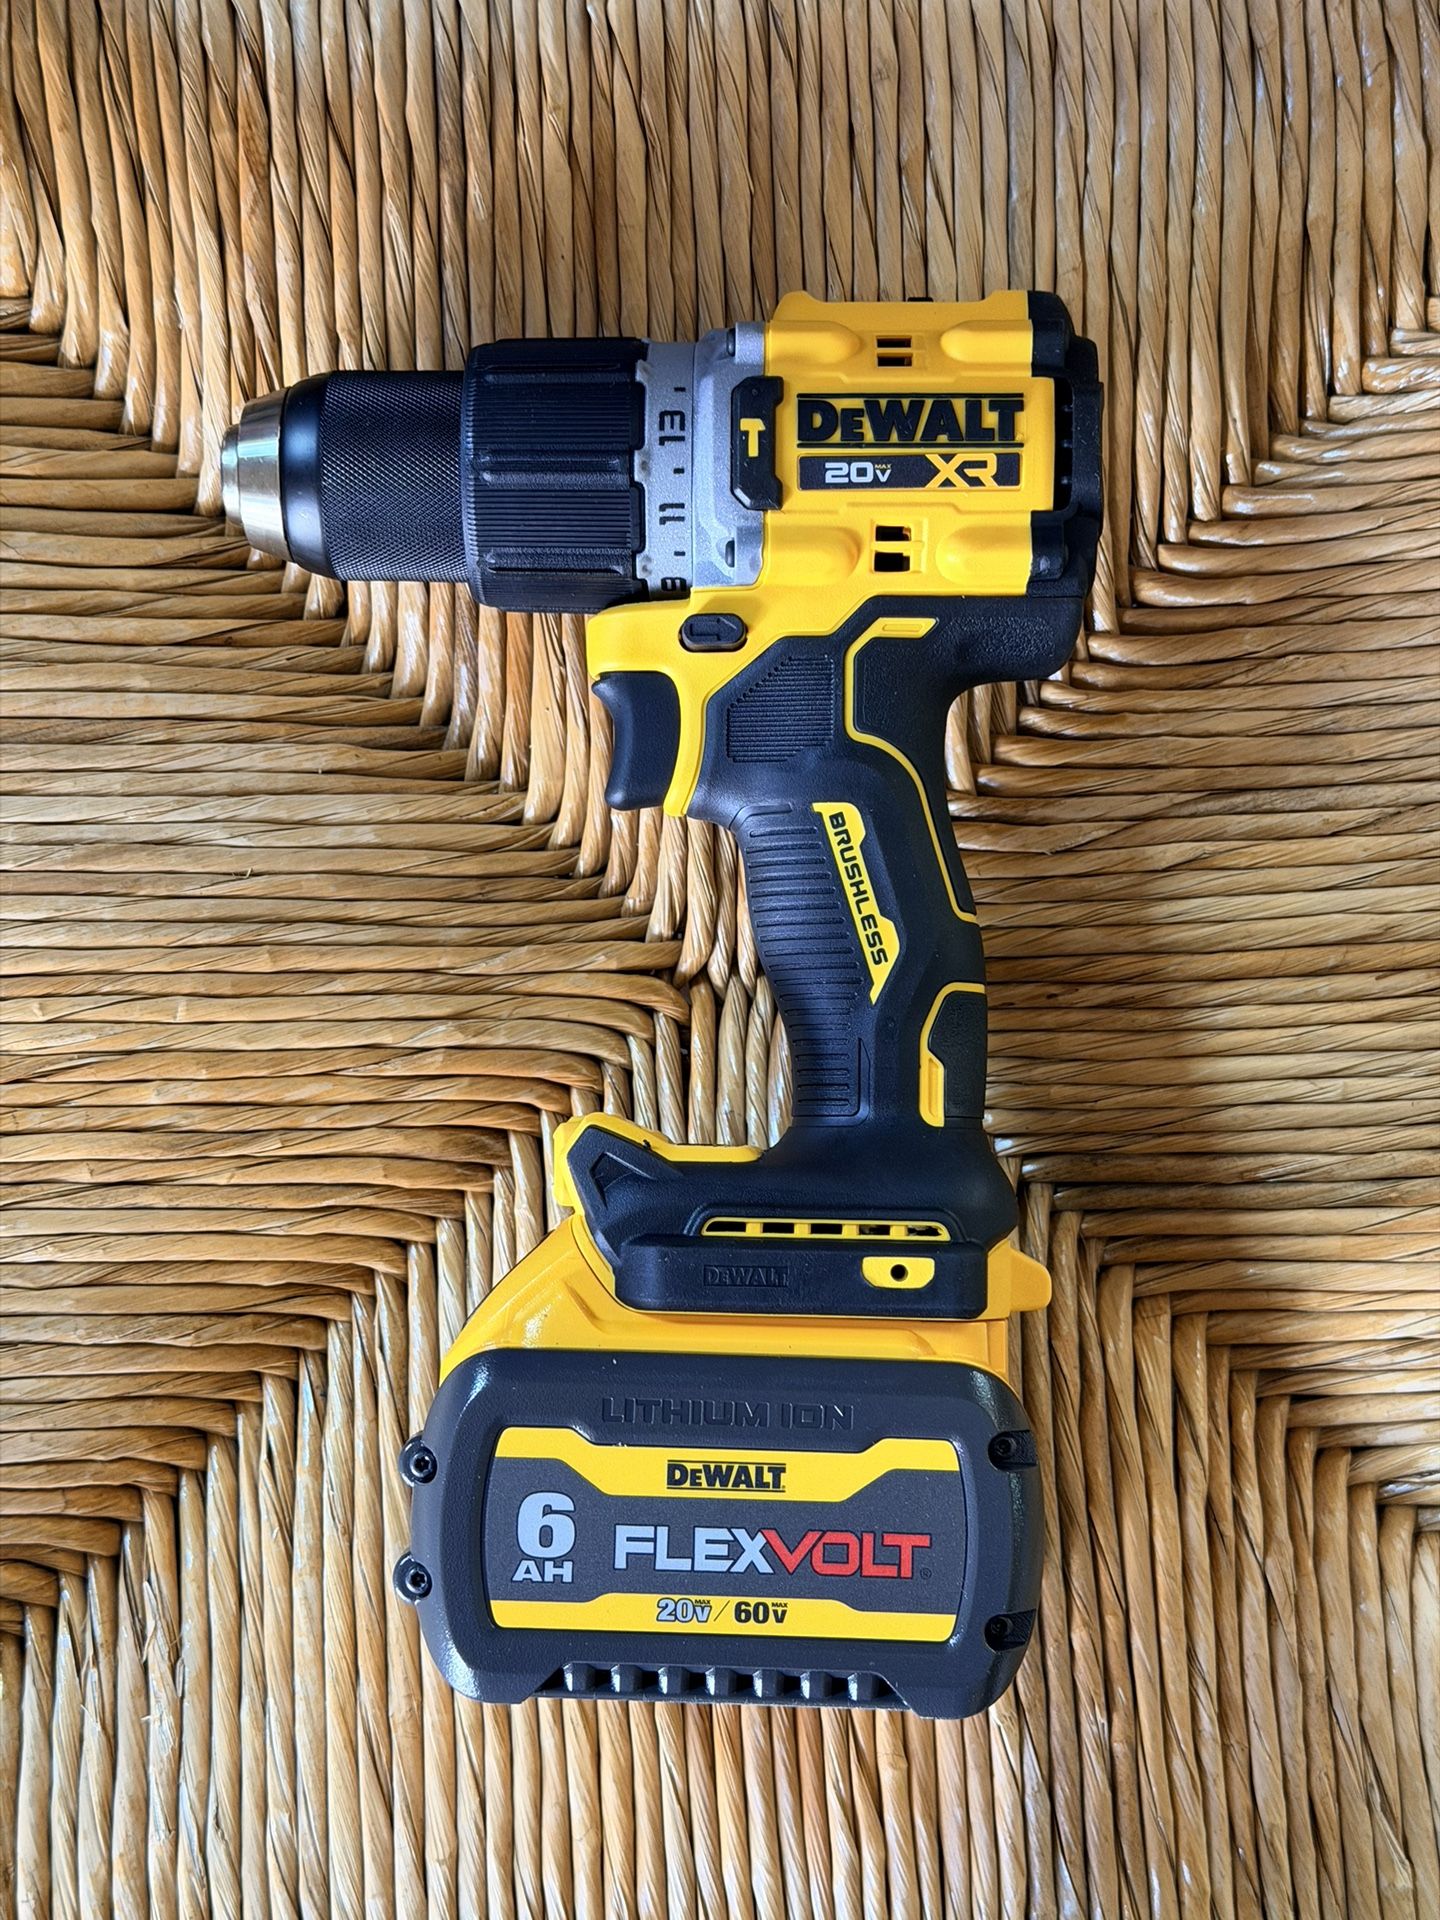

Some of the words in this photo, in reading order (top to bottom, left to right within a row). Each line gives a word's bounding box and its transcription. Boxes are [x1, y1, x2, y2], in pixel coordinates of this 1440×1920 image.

[658, 410, 686, 447] 13
[797, 398, 1024, 443] DEWALT
[924, 452, 1000, 488] XR
[658, 502, 686, 525] 11
[828, 811, 889, 966] BRUSHLESS
[705, 1265, 789, 1287] DEWALT
[602, 1397, 770, 1427] LITHIUM
[781, 1402, 855, 1430] ION
[666, 1462, 786, 1489] DEWALT
[516, 1490, 577, 1560] 6
[612, 1523, 933, 1580] FLEXVOLT
[510, 1559, 575, 1585] AH
